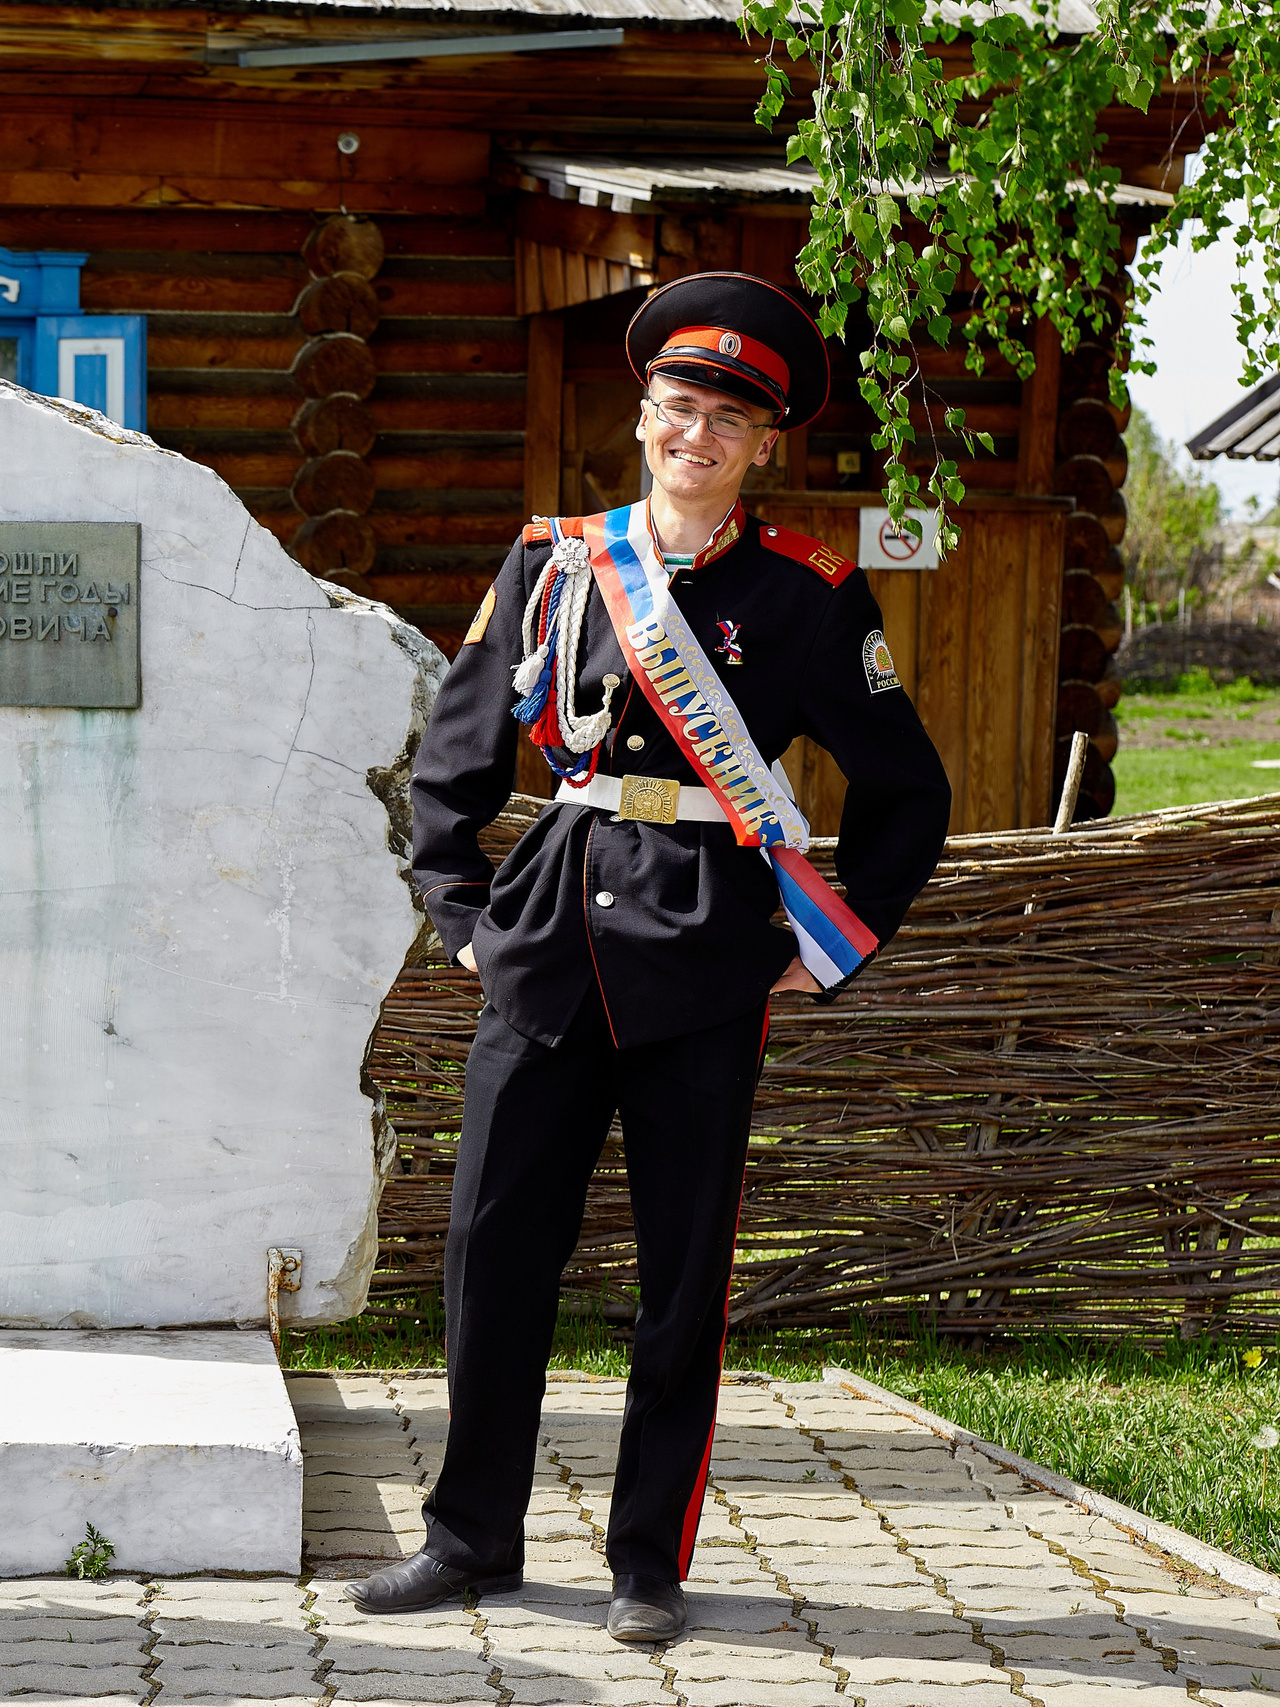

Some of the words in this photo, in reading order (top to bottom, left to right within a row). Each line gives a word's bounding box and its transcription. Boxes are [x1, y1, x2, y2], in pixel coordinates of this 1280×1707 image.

[808, 545, 845, 576] БК
[41, 581, 131, 606] ГОДЫ
[626, 614, 779, 836] ВЫПУСКНИК
